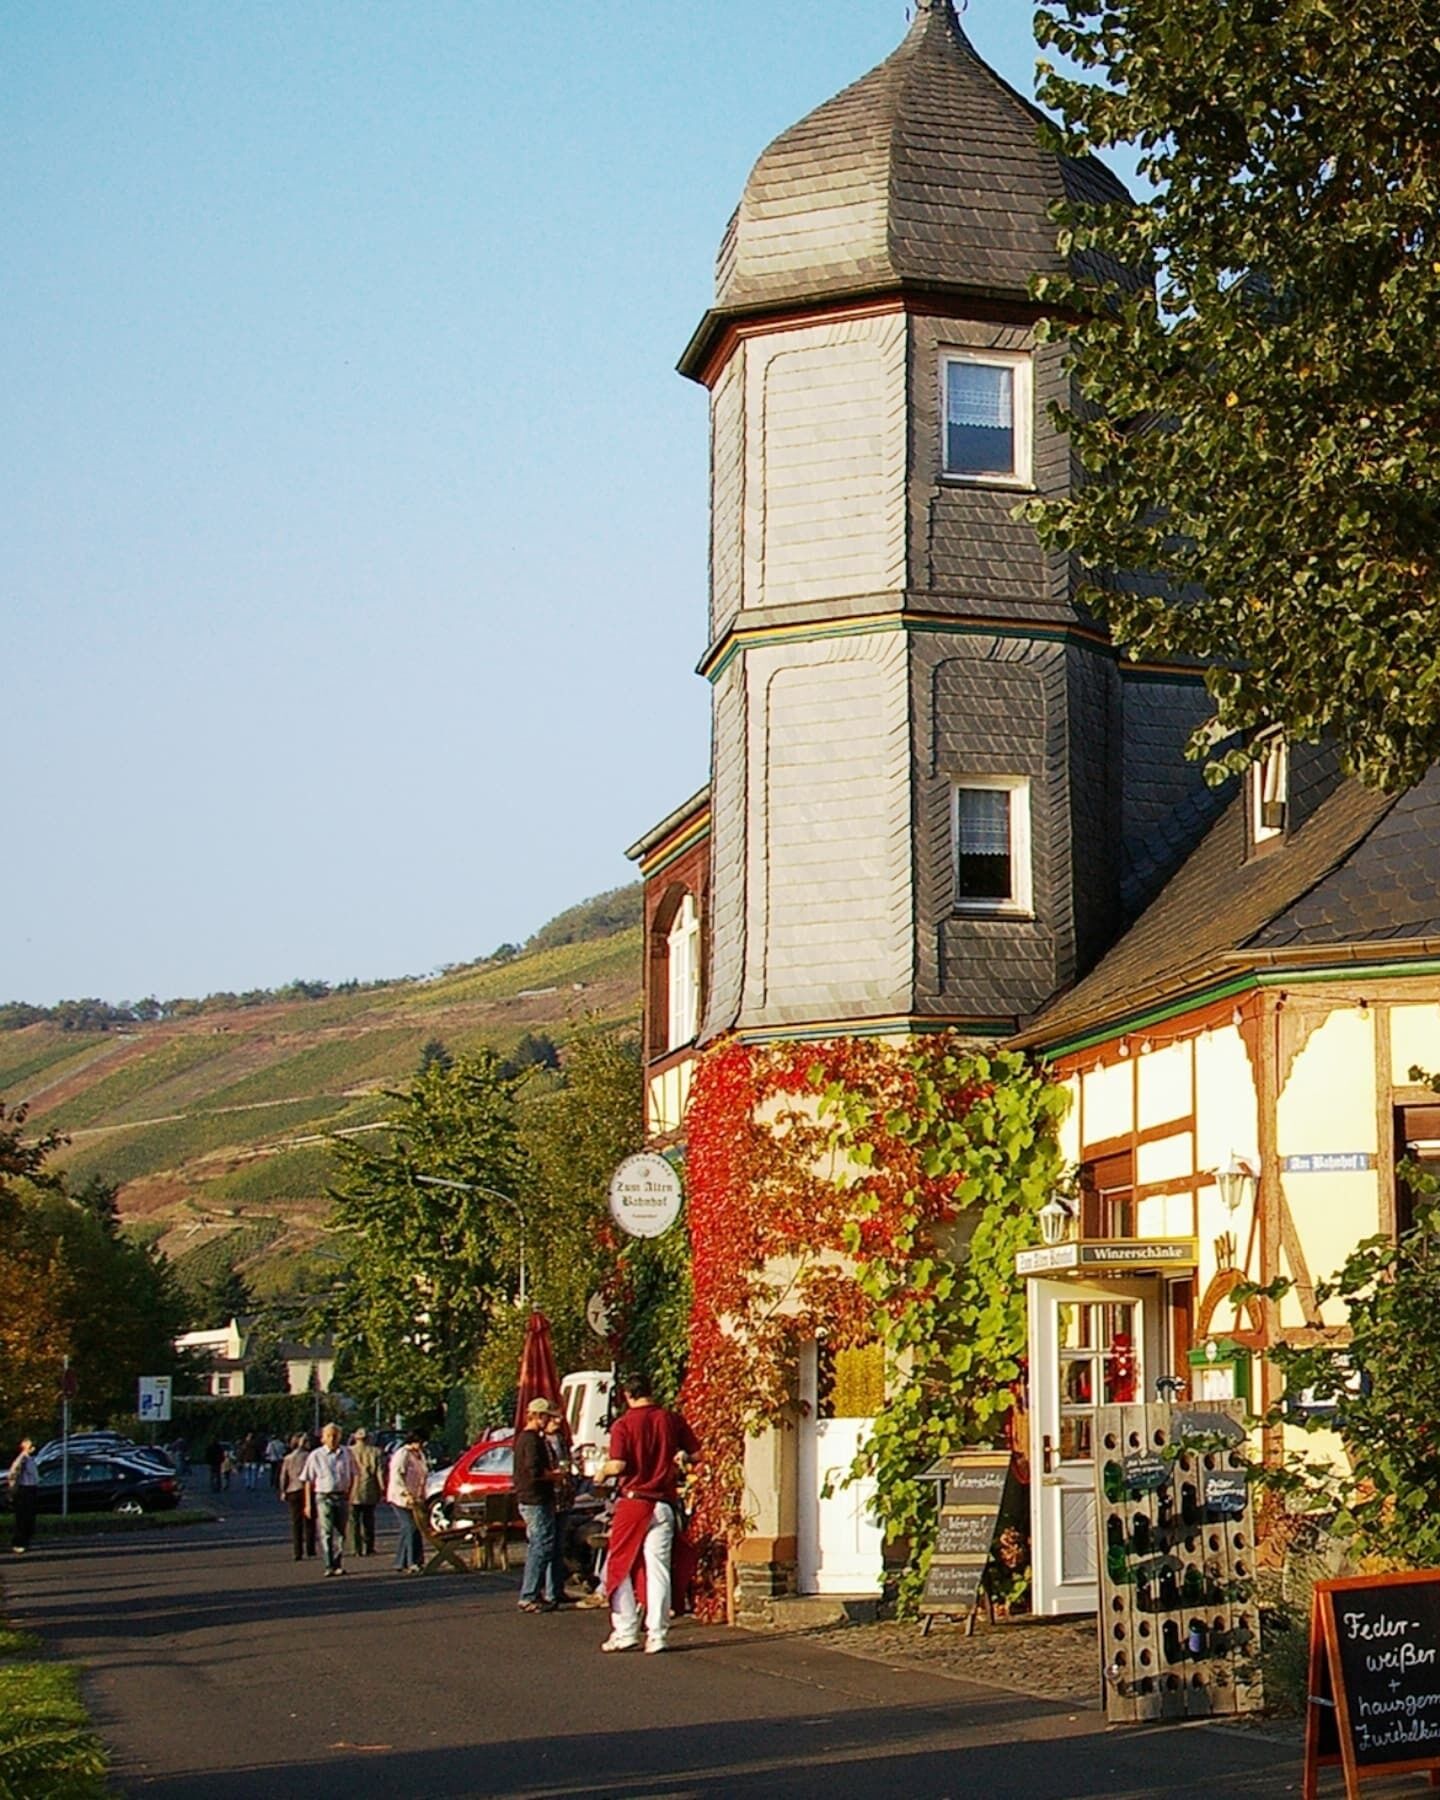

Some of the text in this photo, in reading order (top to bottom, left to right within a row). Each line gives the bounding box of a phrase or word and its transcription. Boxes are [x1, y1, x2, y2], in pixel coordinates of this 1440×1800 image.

[1312, 1155, 1358, 1169] Bahnhof
[616, 1181, 673, 1192] Zum Alten
[622, 1195, 668, 1207] Bahnhof
[1093, 1246, 1184, 1260] Winzerschänke
[1343, 1612, 1421, 1641] Feder-
[1366, 1642, 1437, 1674] weißer
